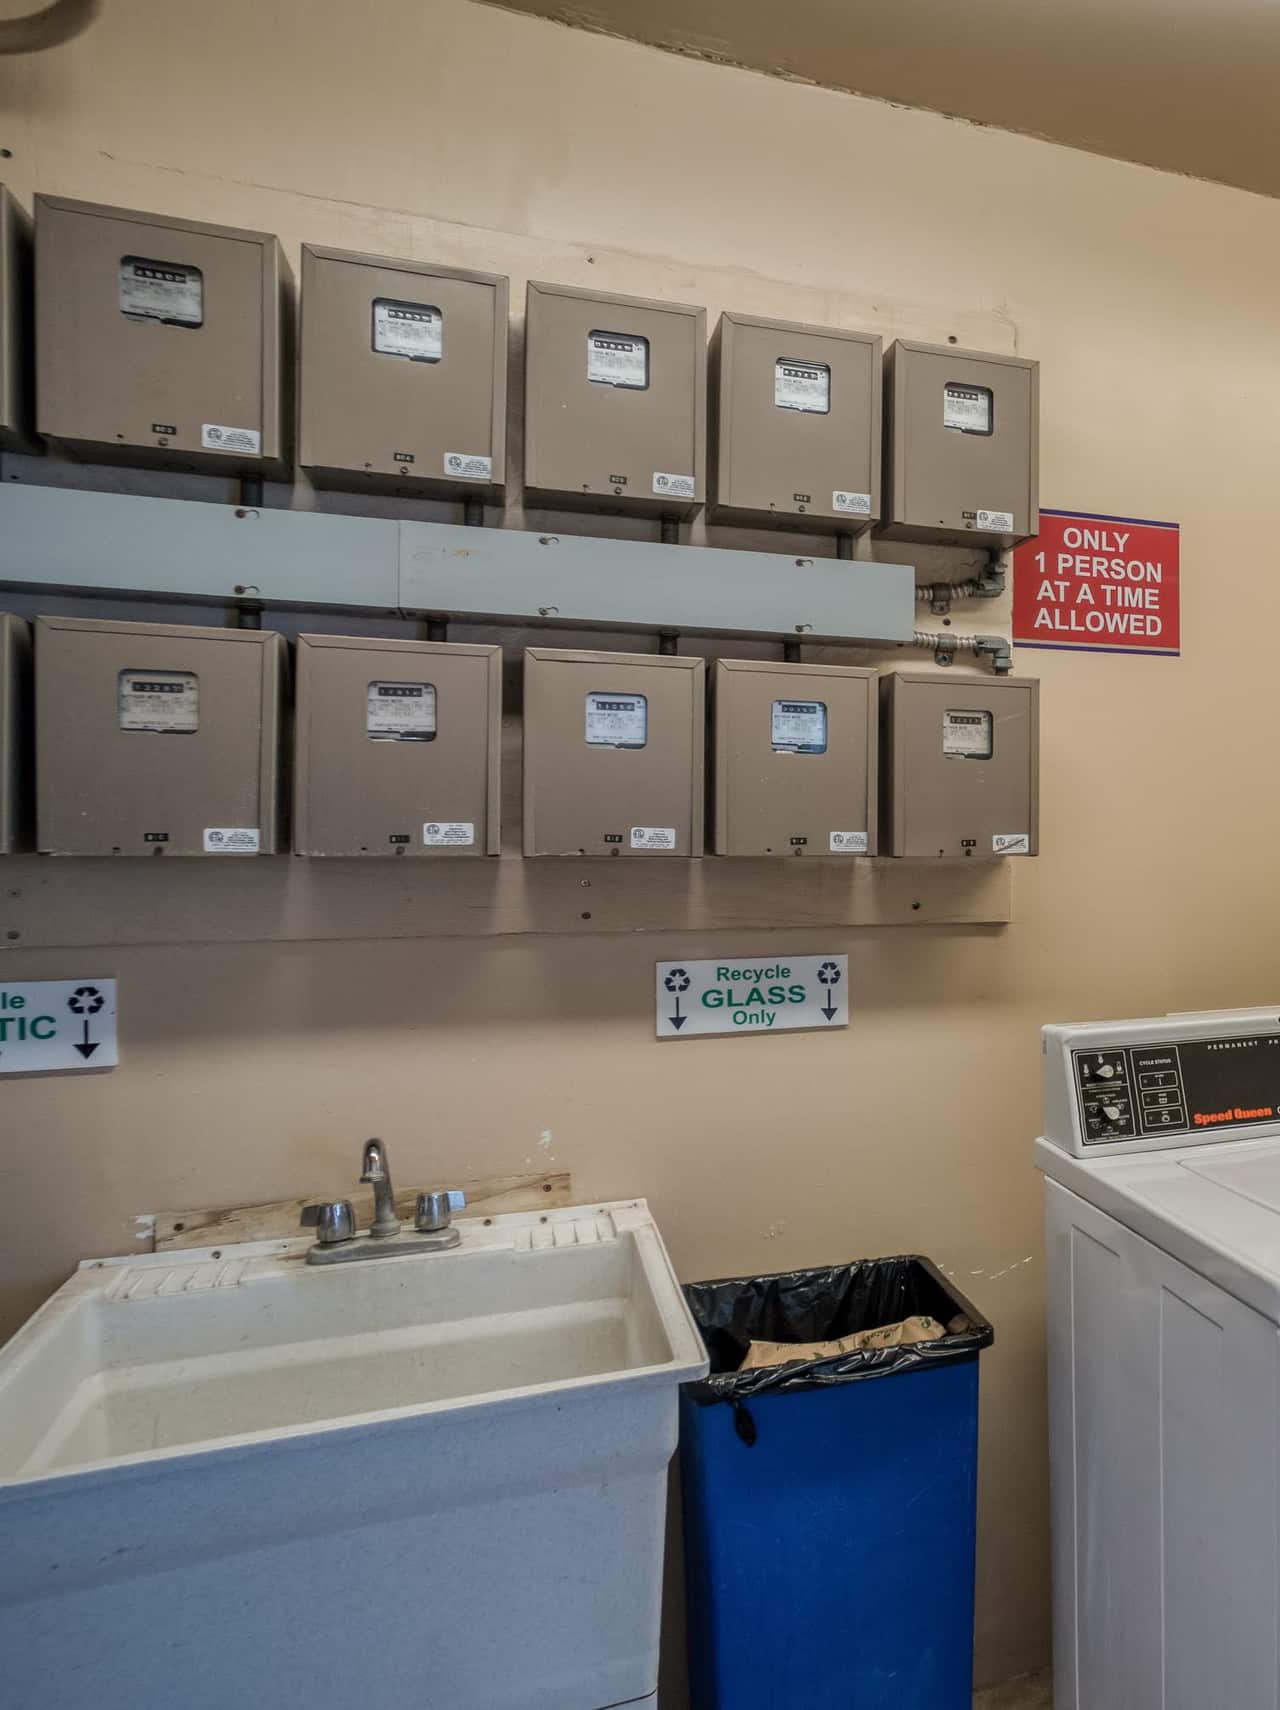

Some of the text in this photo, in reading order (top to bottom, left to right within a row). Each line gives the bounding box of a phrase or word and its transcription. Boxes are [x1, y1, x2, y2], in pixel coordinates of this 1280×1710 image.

[1063, 528, 1130, 553] ONLY
[1034, 552, 1162, 583] 1 PERSON
[1036, 580, 1160, 610] AT A TIME
[1034, 607, 1162, 636] ALLOWED
[716, 964, 792, 983] Recycle
[701, 985, 807, 1008] GLASS
[732, 1009, 777, 1027] Only
[1207, 1040, 1258, 1050] PERMANENT
[1194, 1109, 1233, 1125] Speed
[1234, 1106, 1273, 1120] Queen
